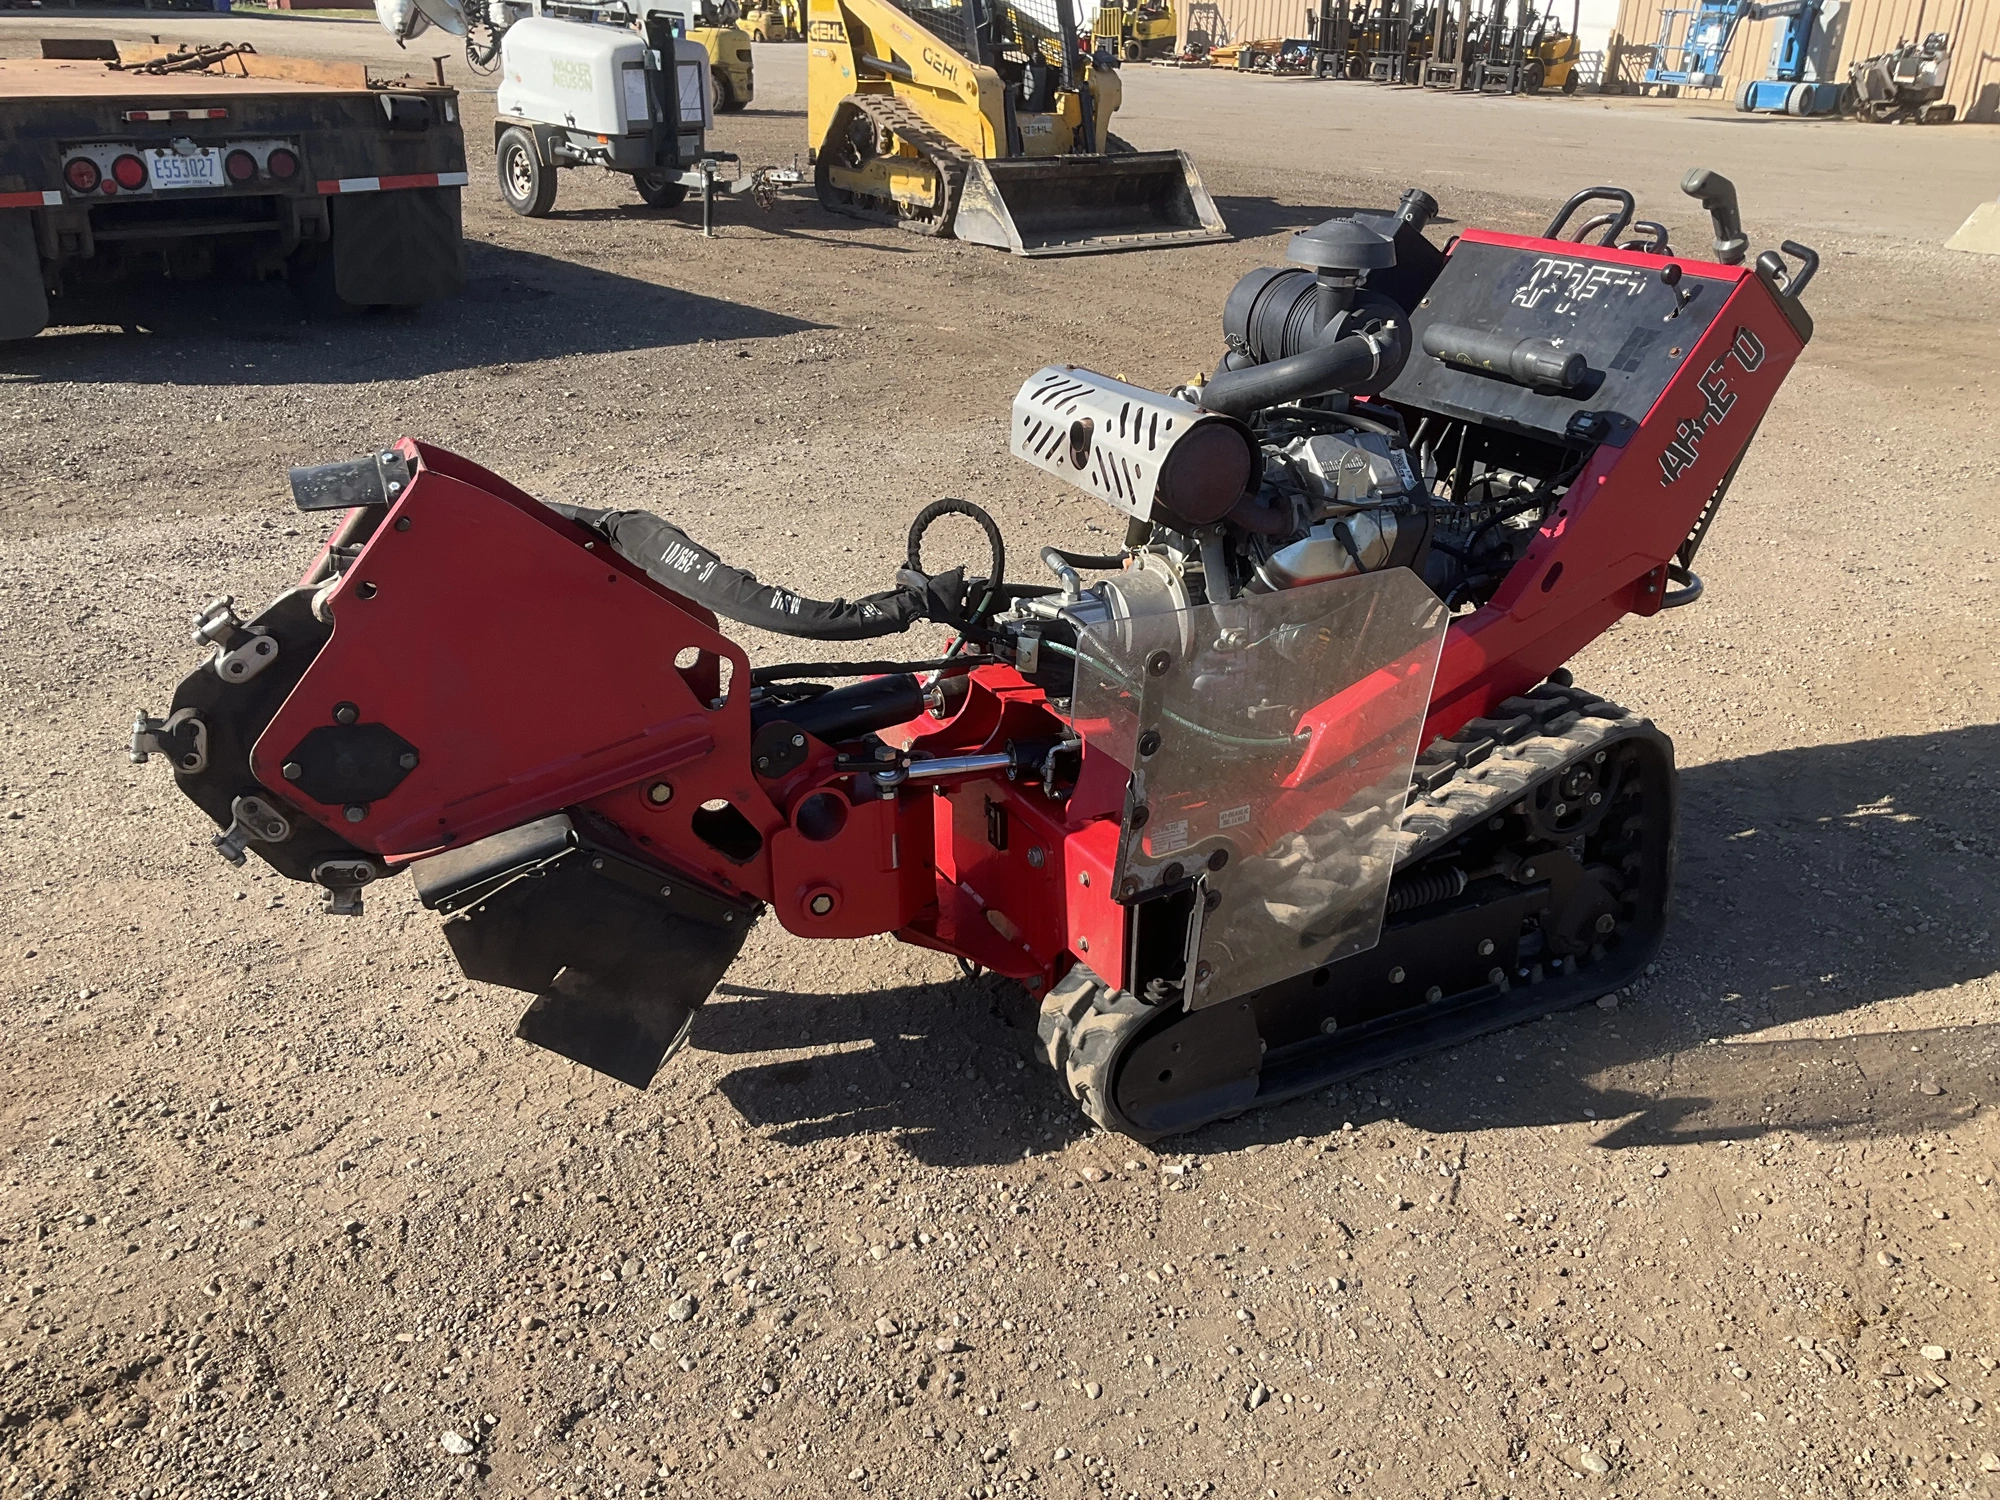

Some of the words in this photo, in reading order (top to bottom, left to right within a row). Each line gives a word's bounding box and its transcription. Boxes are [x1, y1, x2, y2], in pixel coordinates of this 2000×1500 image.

[809, 21, 847, 43] GEHL
[550, 58, 592, 77] WACKER
[922, 47, 960, 87] GEHL
[553, 73, 593, 92] NEUSON
[153, 158, 214, 179] E553027
